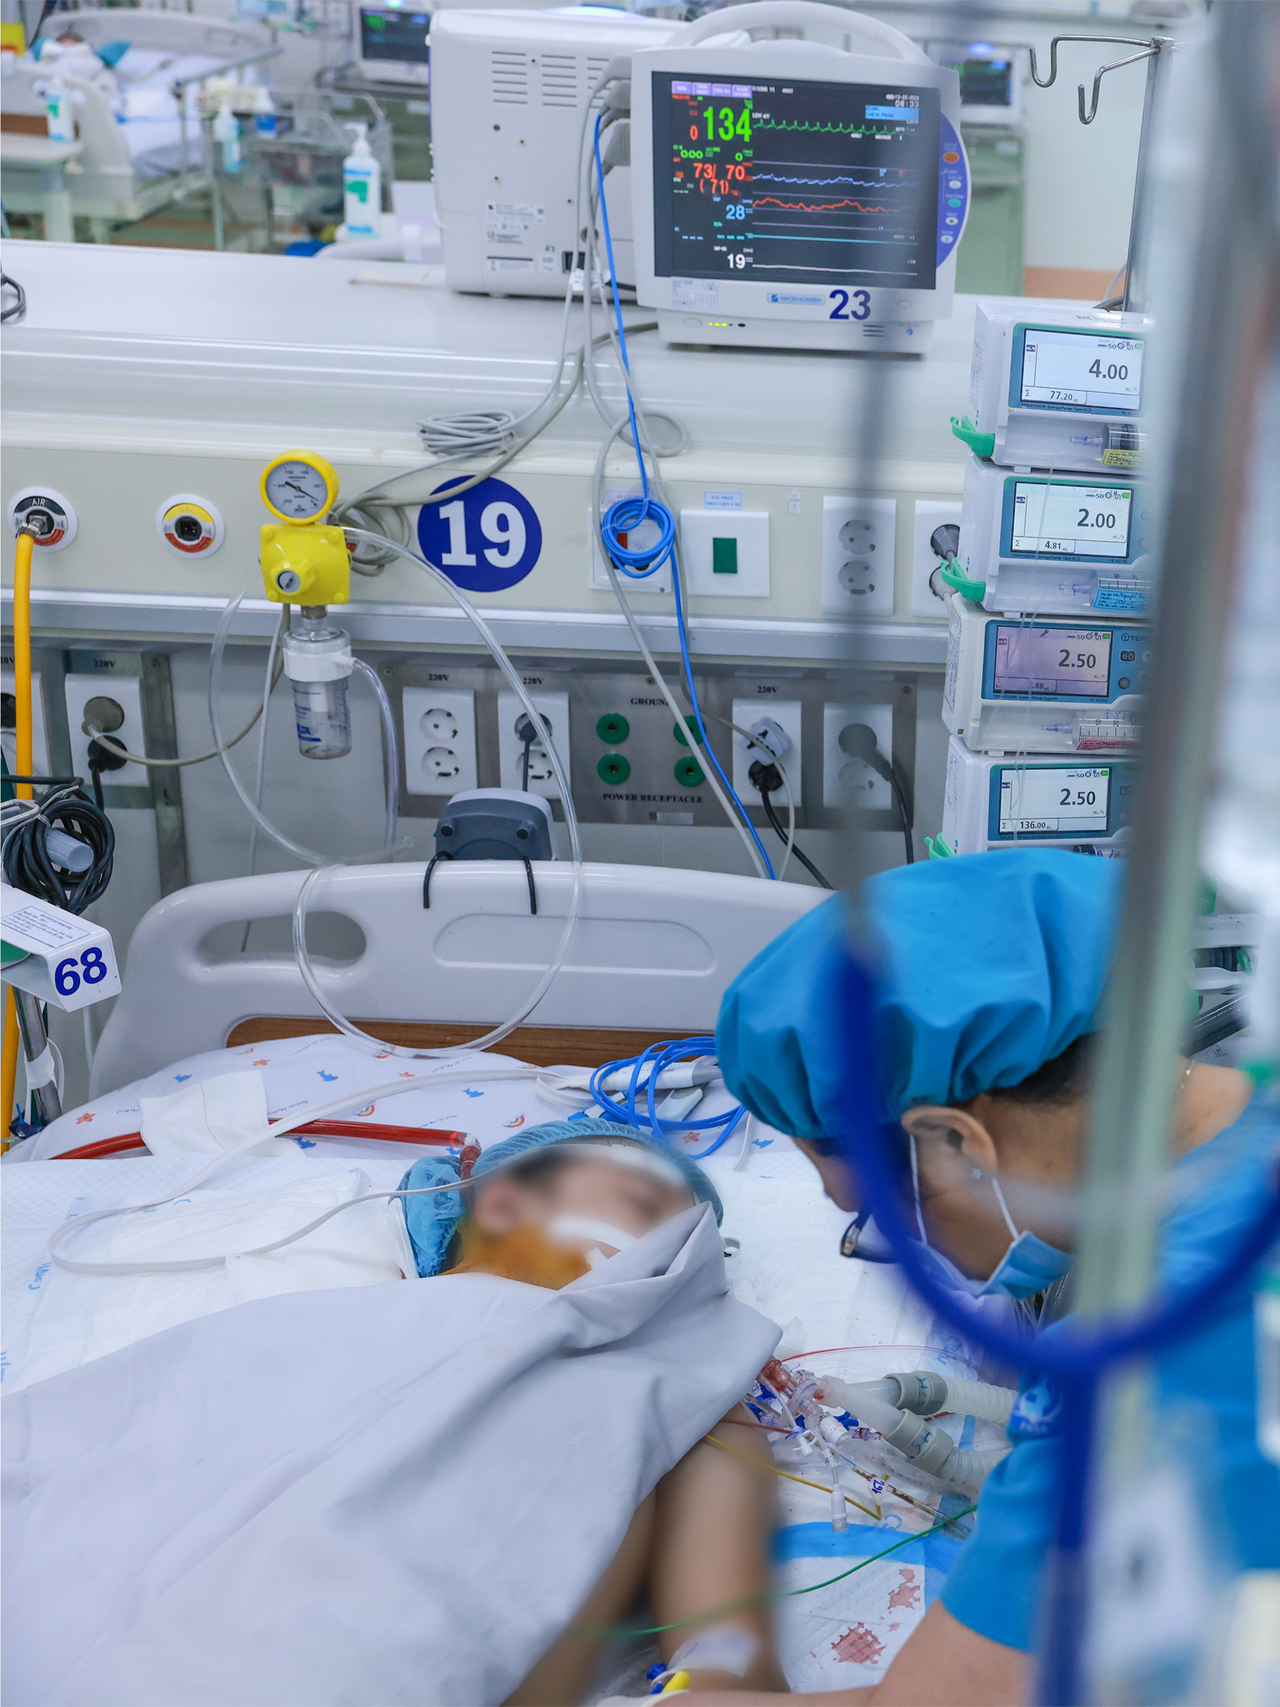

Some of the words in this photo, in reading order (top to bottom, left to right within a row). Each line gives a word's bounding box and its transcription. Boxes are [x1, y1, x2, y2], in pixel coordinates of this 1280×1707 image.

[703, 106, 753, 143] 134
[725, 164, 746, 181] 70
[725, 203, 747, 220] 28
[726, 252, 747, 270] 19
[828, 288, 872, 321] 23
[1088, 358, 1129, 381] 4.00
[1050, 390, 1073, 401] 77.20
[32, 497, 46, 507] AIR
[1077, 508, 1116, 529] 2.00
[439, 500, 527, 570] 19
[1044, 540, 1062, 550] 4.81
[1058, 648, 1097, 669] 2.50
[428, 673, 450, 682] 220V
[522, 677, 545, 686] 220V
[757, 685, 779, 694] 220V
[630, 697, 671, 707] GROUN
[603, 792, 638, 802] POWER
[640, 794, 704, 804] RECEPTACLE
[1059, 788, 1096, 806] 2.50
[1020, 820, 1046, 830] 136.00
[54, 946, 108, 996] 68
